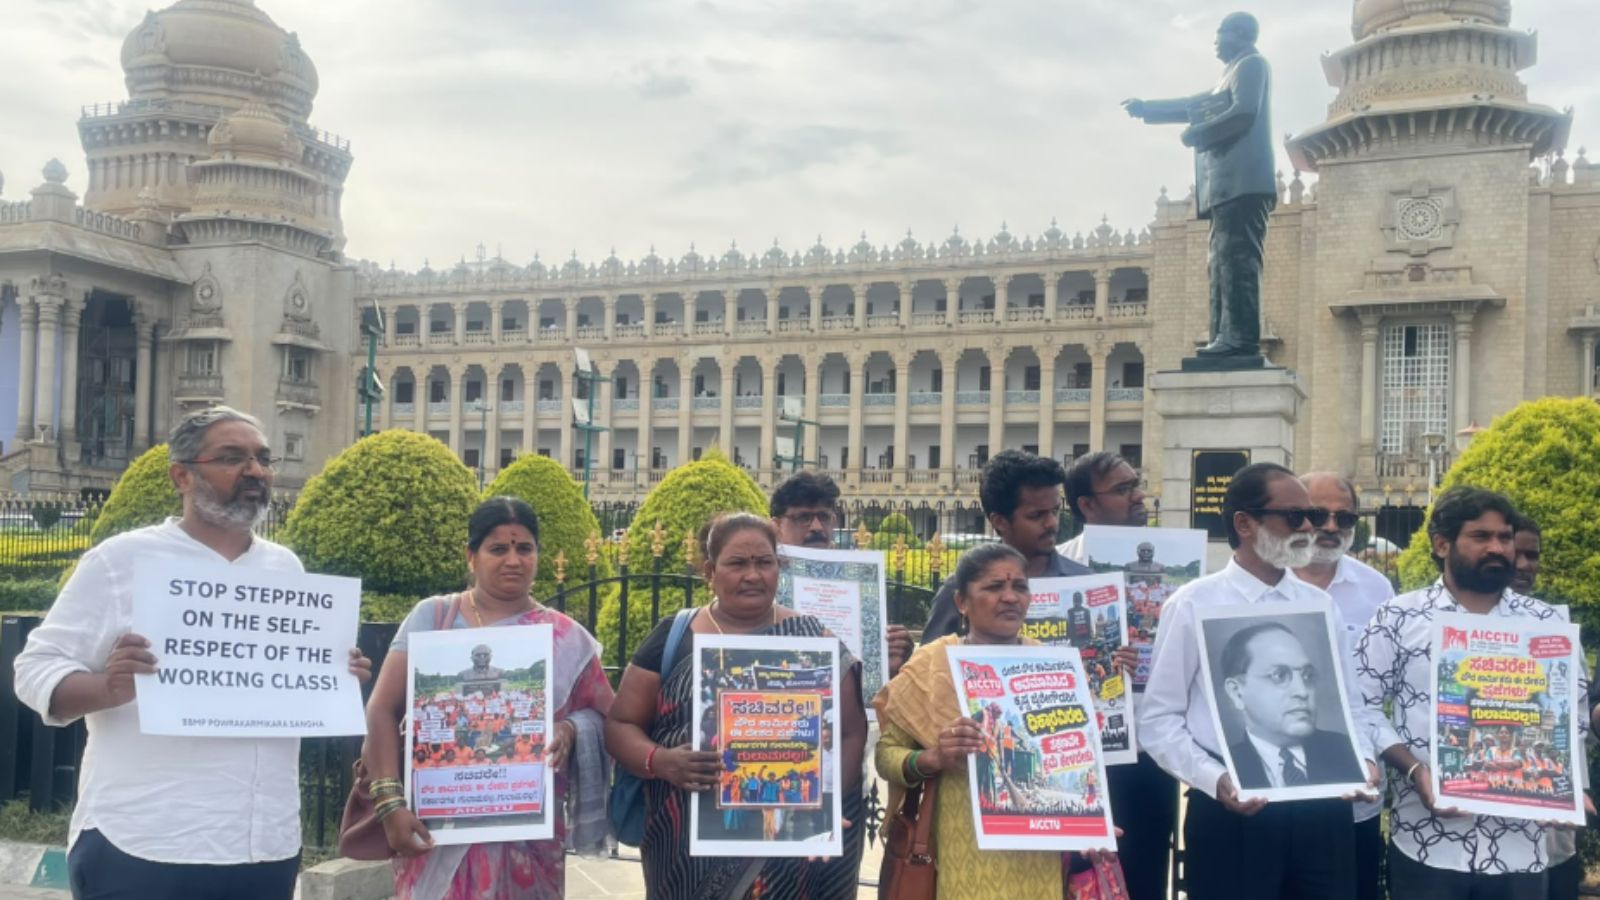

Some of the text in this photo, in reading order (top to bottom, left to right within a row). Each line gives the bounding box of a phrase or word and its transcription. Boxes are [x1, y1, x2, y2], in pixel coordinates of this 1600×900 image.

[169, 579, 334, 609] STOP STEPPING
[1030, 592, 1060, 604] ICCTU
[183, 609, 321, 635] ON THE SELF-
[1470, 630, 1519, 643] AICCTU
[164, 638, 333, 664] RESPECT OF THE
[157, 668, 338, 691] WORKING CLASS!
[966, 680, 1001, 690] AICCTU
[289, 720, 324, 728] SANGHA
[454, 805, 513, 814] AICCTU
[1029, 819, 1060, 830] AICCTU
